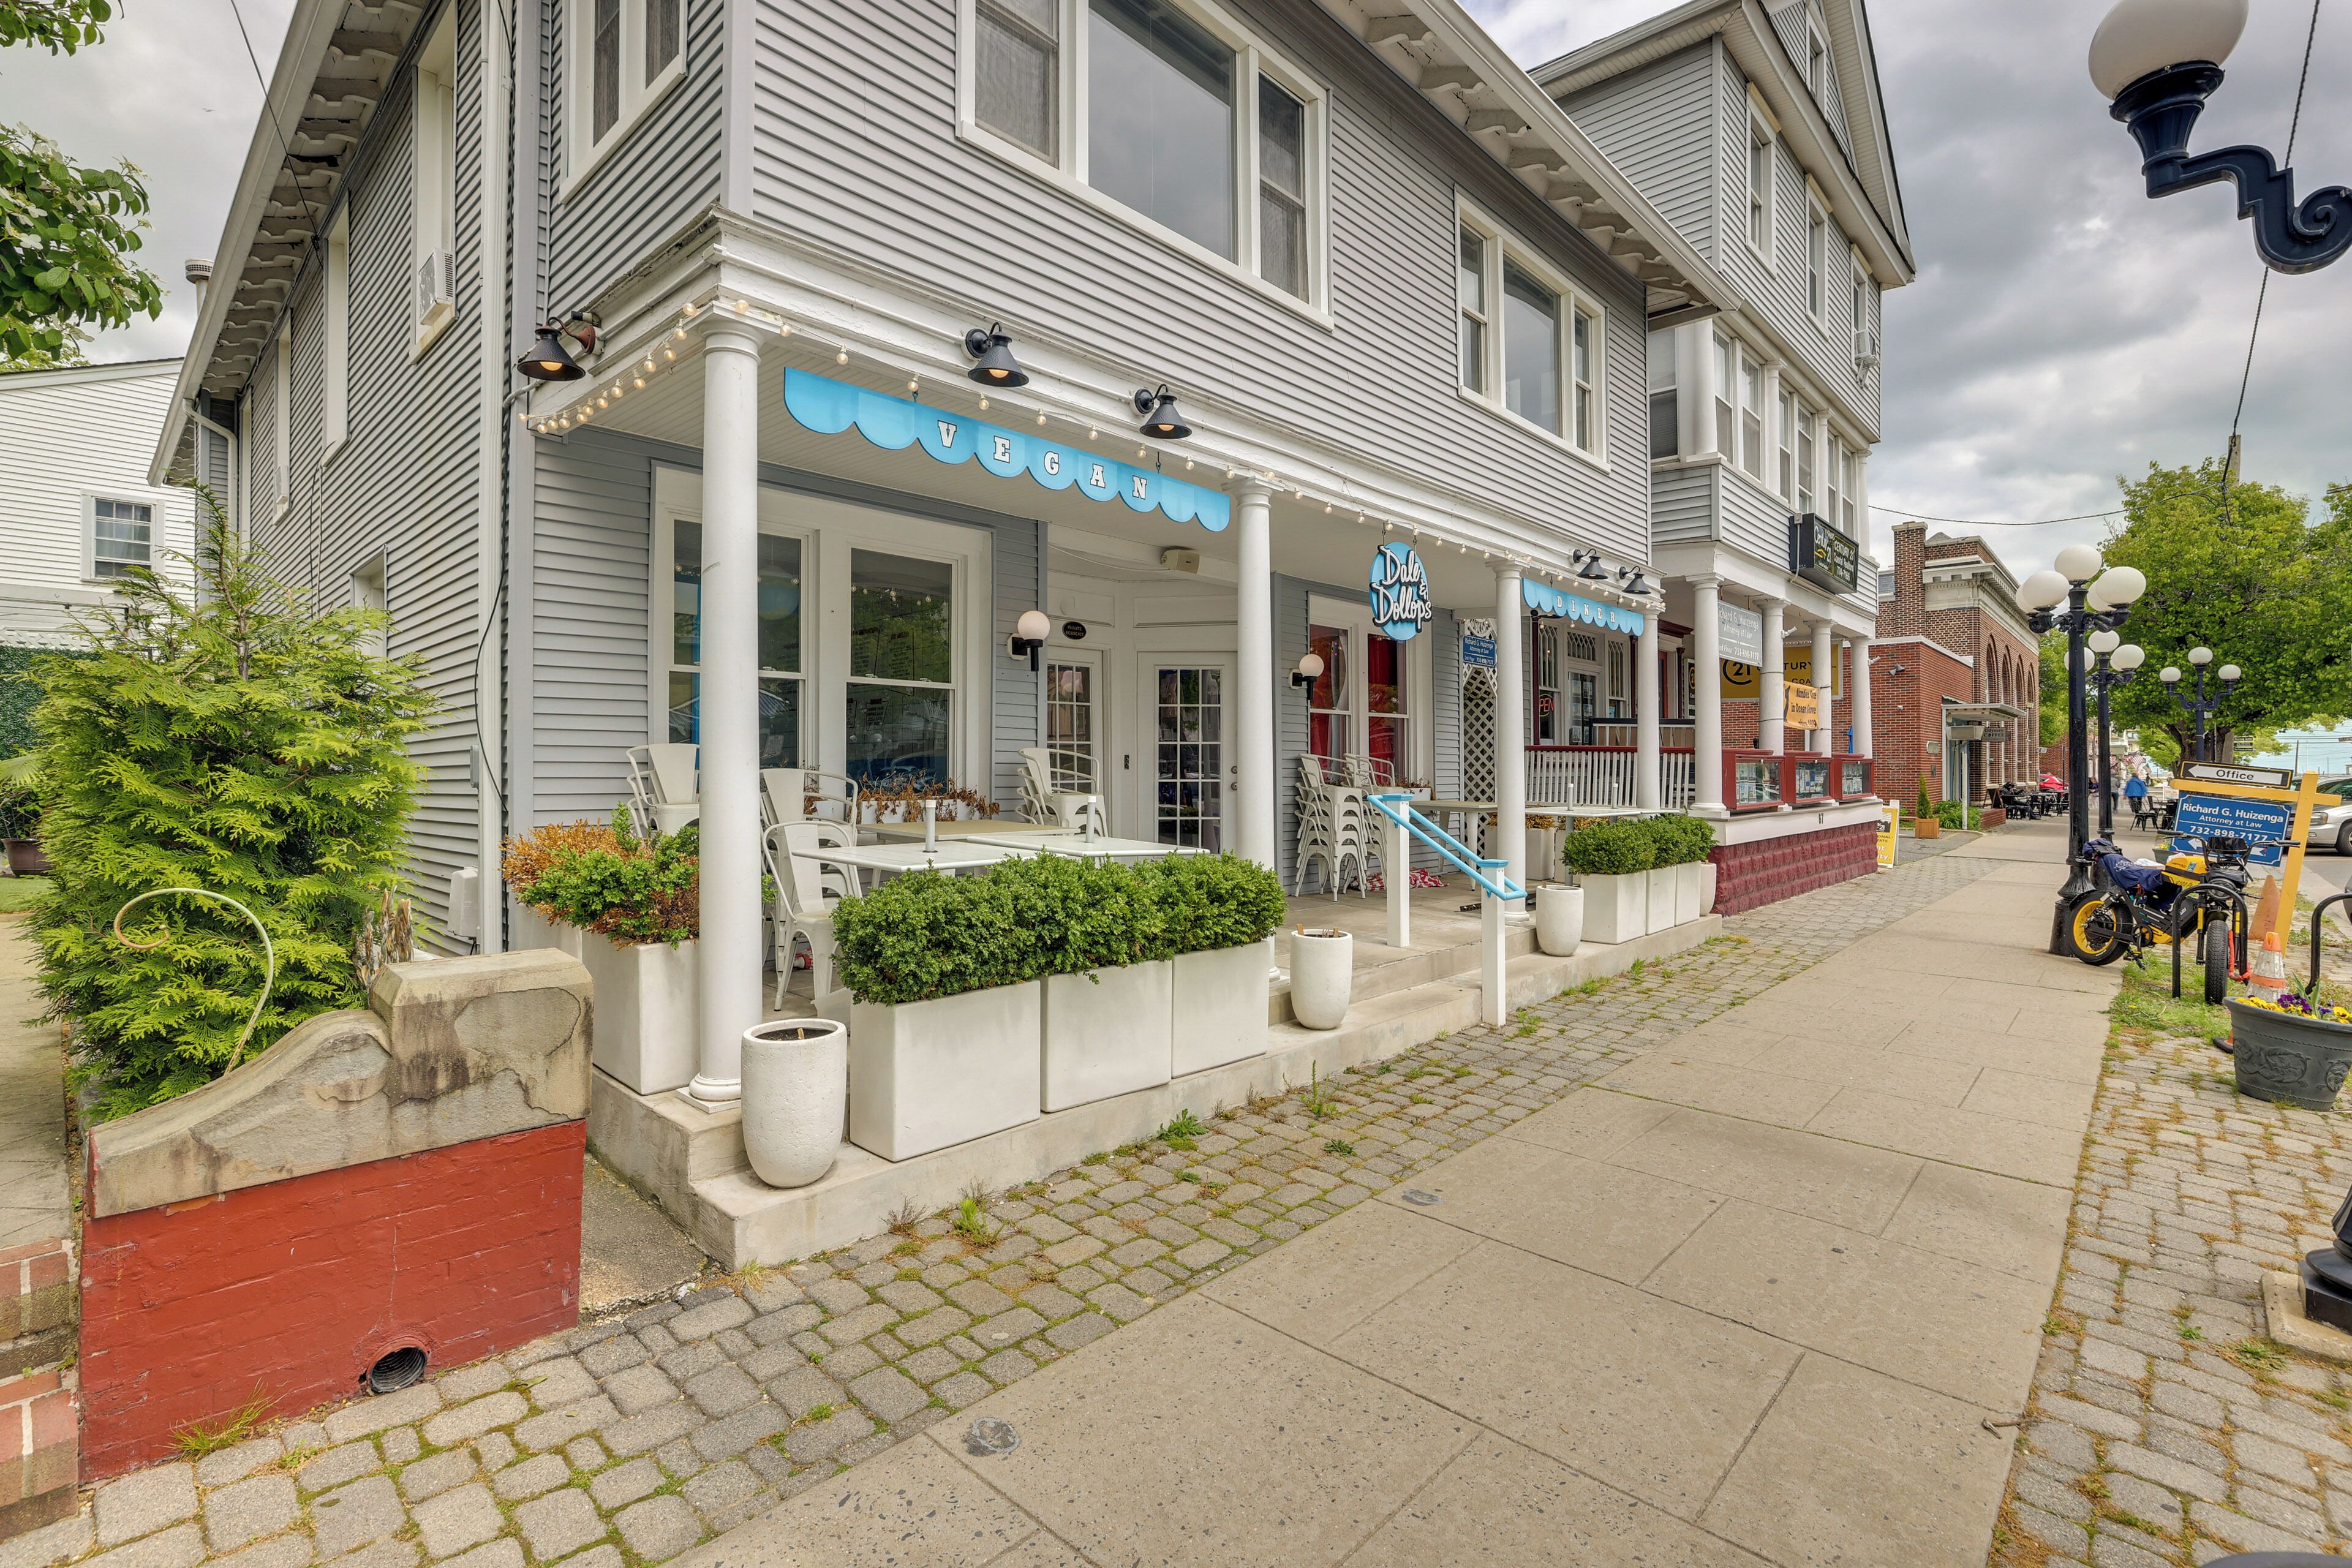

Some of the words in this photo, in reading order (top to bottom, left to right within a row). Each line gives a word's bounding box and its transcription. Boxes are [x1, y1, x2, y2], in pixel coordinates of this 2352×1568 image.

[937, 420, 1147, 500] VEGAN
[1834, 540, 1850, 559] CENTURY
[1378, 545, 1421, 586] Dale
[1419, 578, 1427, 600] &
[1370, 582, 1432, 631] Dollops
[1556, 595, 1616, 624] DINER
[1724, 623, 1740, 638] Attorney
[1739, 614, 1759, 632] Huizenga
[1539, 698, 1555, 712] PEN
[2216, 769, 2254, 780] Office
[1819, 813, 1824, 824] 67
[2182, 803, 2218, 815] Richard
[2221, 808, 2232, 816] G.
[2236, 809, 2284, 823] Huizenga
[2199, 815, 2234, 826] Attorney
[2190, 825, 2268, 842] 732-898-7177
